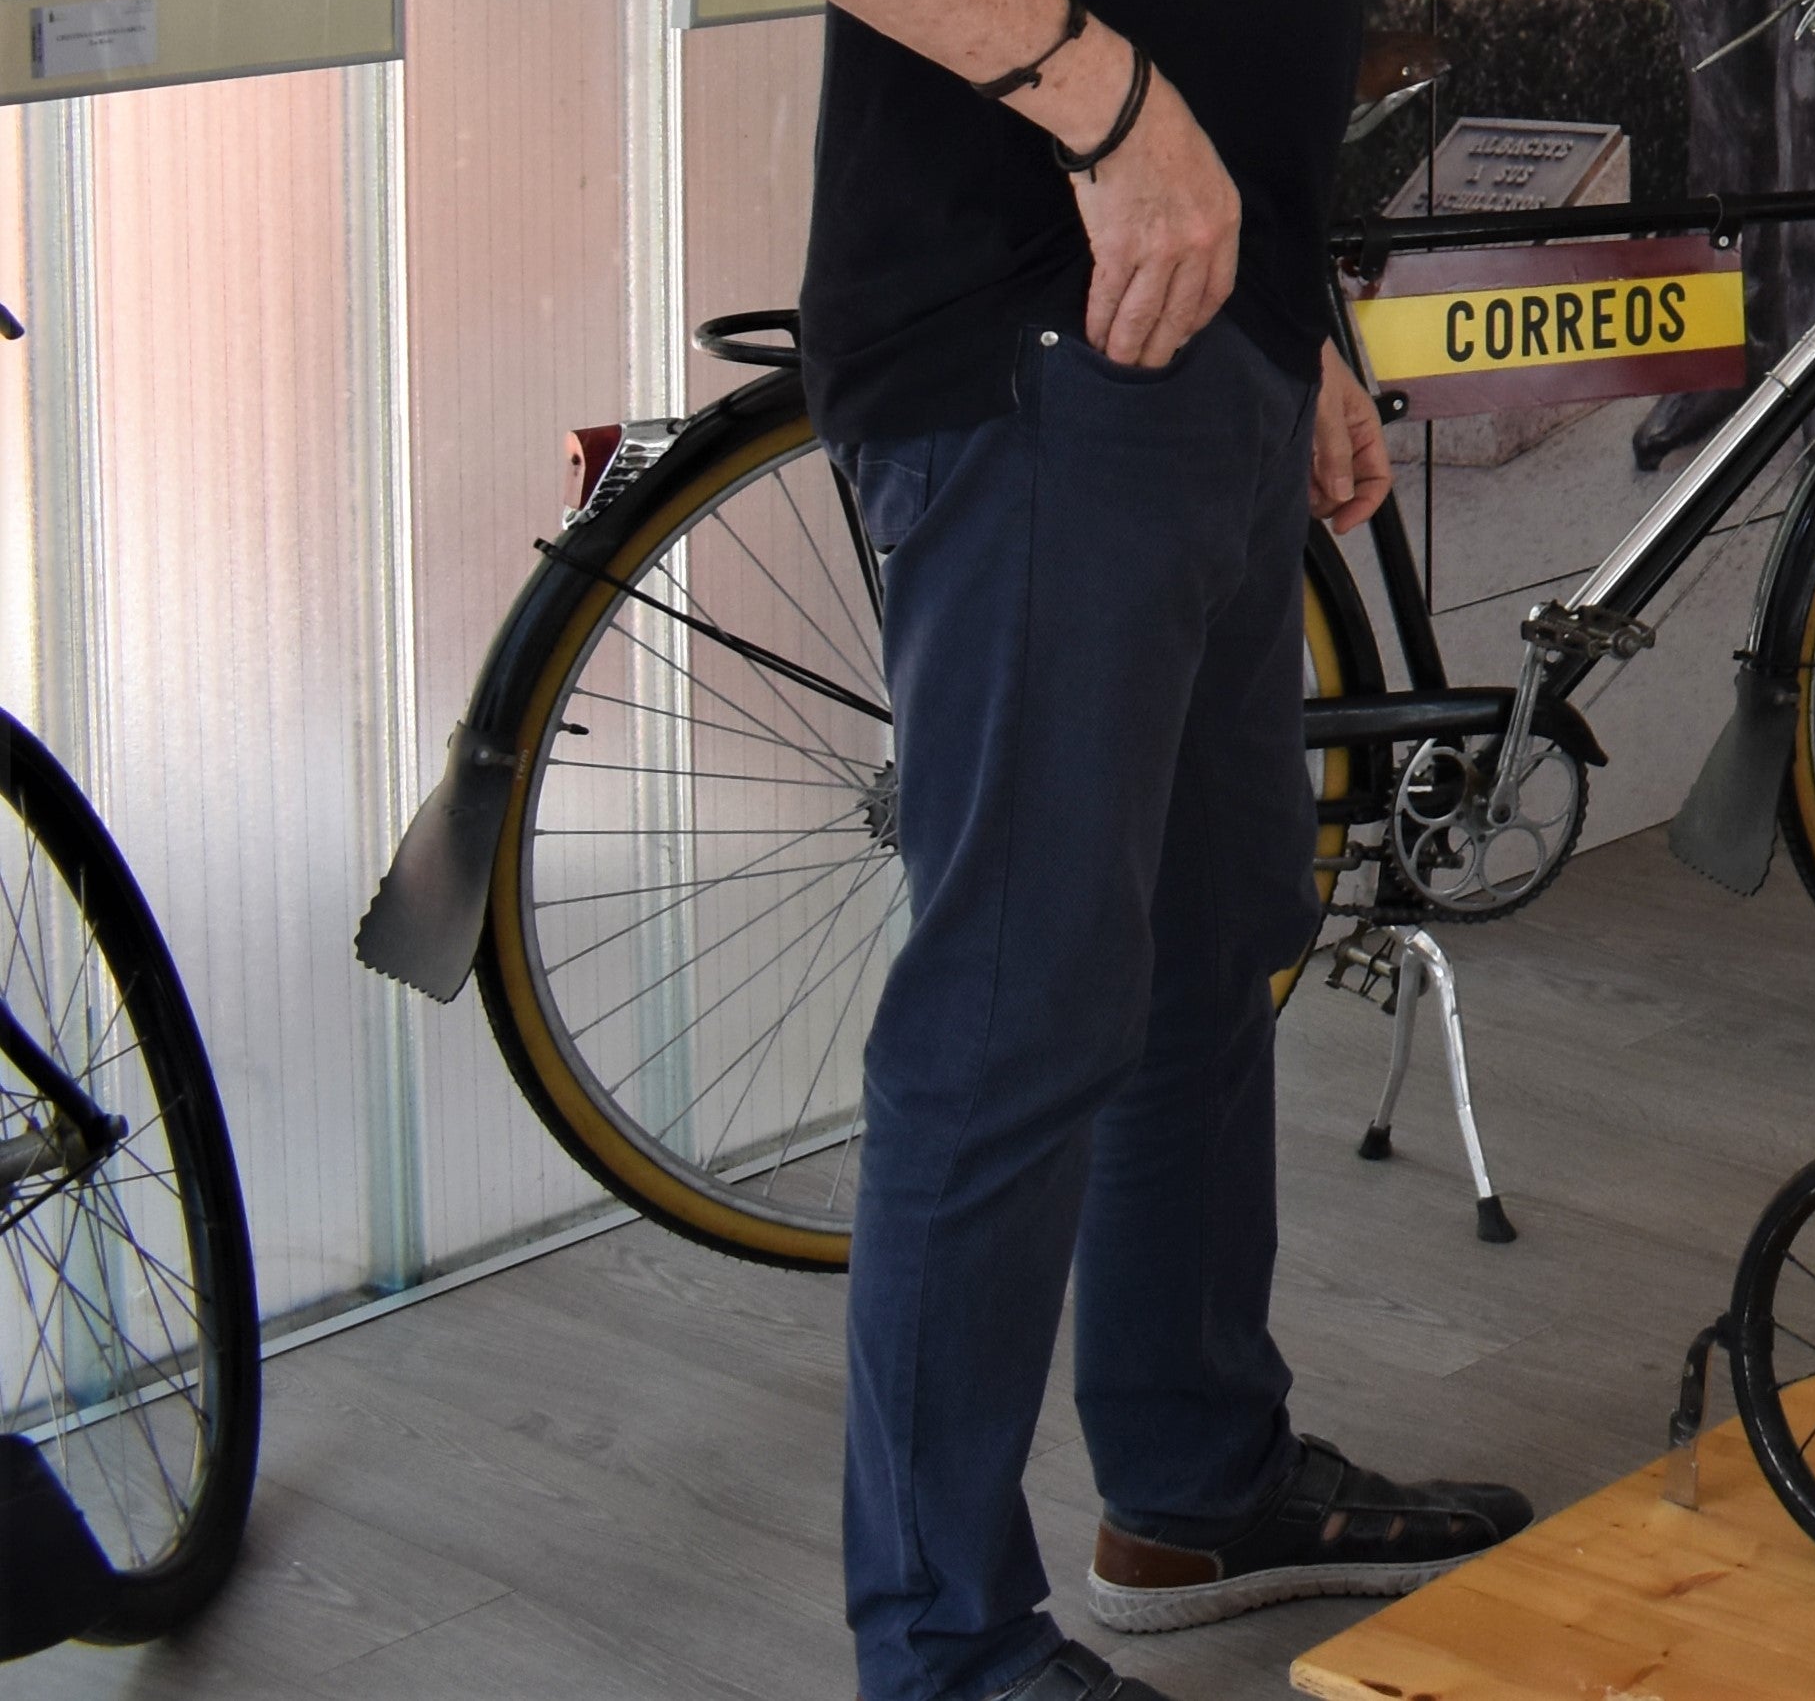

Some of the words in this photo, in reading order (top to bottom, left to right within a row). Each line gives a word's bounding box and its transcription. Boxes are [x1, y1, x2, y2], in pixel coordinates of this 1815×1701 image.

[1468, 135, 1574, 161] ALBACETE
[1493, 164, 1535, 185] SUS
[1445, 281, 1687, 364] CORREOS
